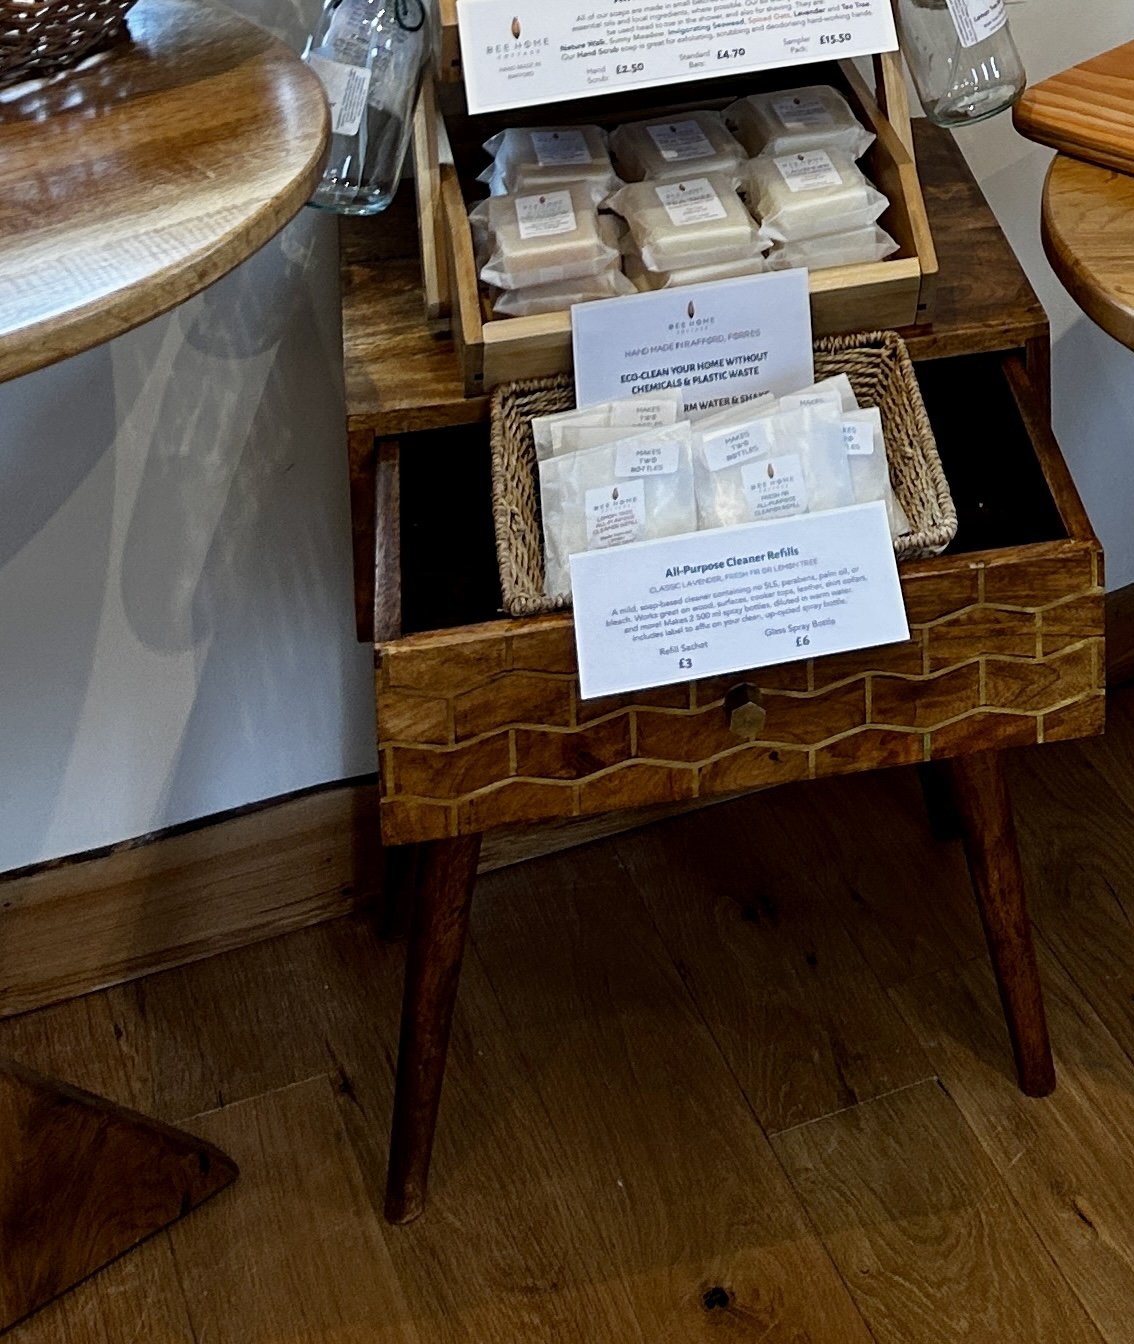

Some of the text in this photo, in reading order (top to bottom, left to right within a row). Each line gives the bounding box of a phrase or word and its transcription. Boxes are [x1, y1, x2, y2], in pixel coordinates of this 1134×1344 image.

[487, 38, 549, 54] BEE HOME
[820, 33, 851, 45] £15.50
[717, 48, 745, 59] £4.70
[616, 63, 644, 74] £2.50
[668, 322, 686, 331] BEE
[625, 348, 649, 358] HAND
[651, 343, 673, 353] MADE
[728, 329, 761, 340] FORRES
[620, 351, 768, 383] ECO-CLEAN YOUR HOME WITHOUT
[632, 366, 759, 395] CHEMICALS & PLASTIC WASTE
[699, 397, 730, 409] WATER
[732, 395, 739, 404] &
[725, 432, 750, 444] MAKES
[726, 446, 759, 461] BOTTLES
[666, 546, 799, 578] All-Purpose Cleaner Refills
[765, 618, 836, 636] Glass Spray Bottle
[796, 634, 810, 647] £6
[660, 641, 708, 655] Refill Sachet
[679, 658, 692, 668] £3
